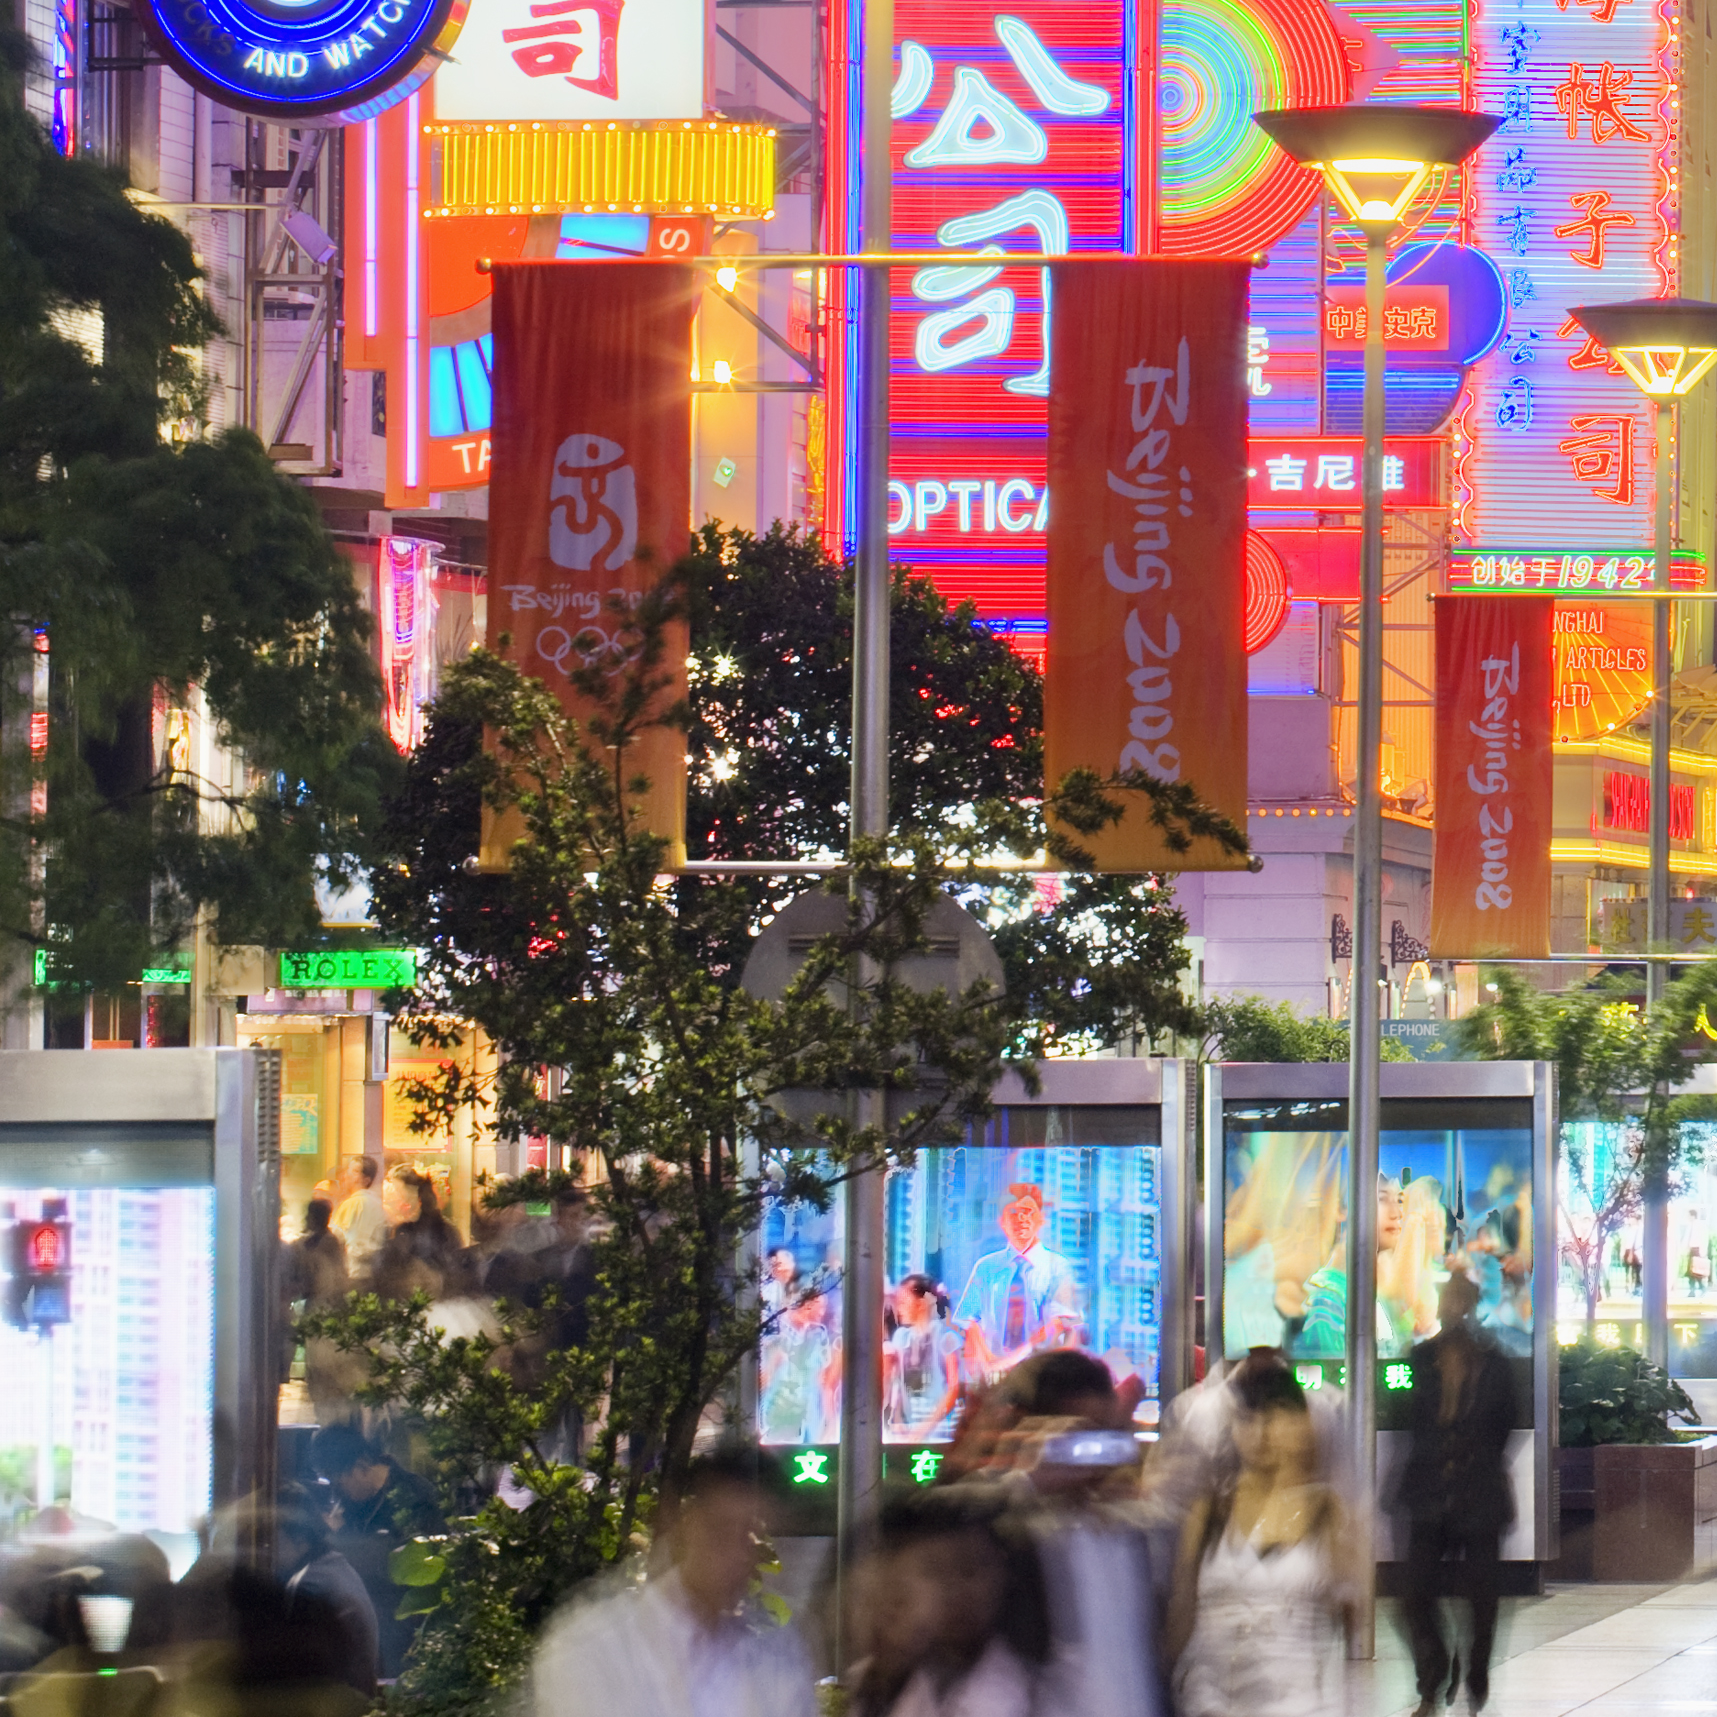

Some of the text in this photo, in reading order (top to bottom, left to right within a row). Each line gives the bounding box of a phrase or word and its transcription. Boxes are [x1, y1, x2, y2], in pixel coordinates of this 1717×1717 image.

[242, 46, 309, 80] AND
[1104, 335, 1195, 596] Beijing
[1467, 640, 1521, 913] Beijing 2008
[289, 953, 407, 983] ROLEX
[1294, 1363, 1415, 1392] 明我
[793, 1449, 945, 1484] 文在
